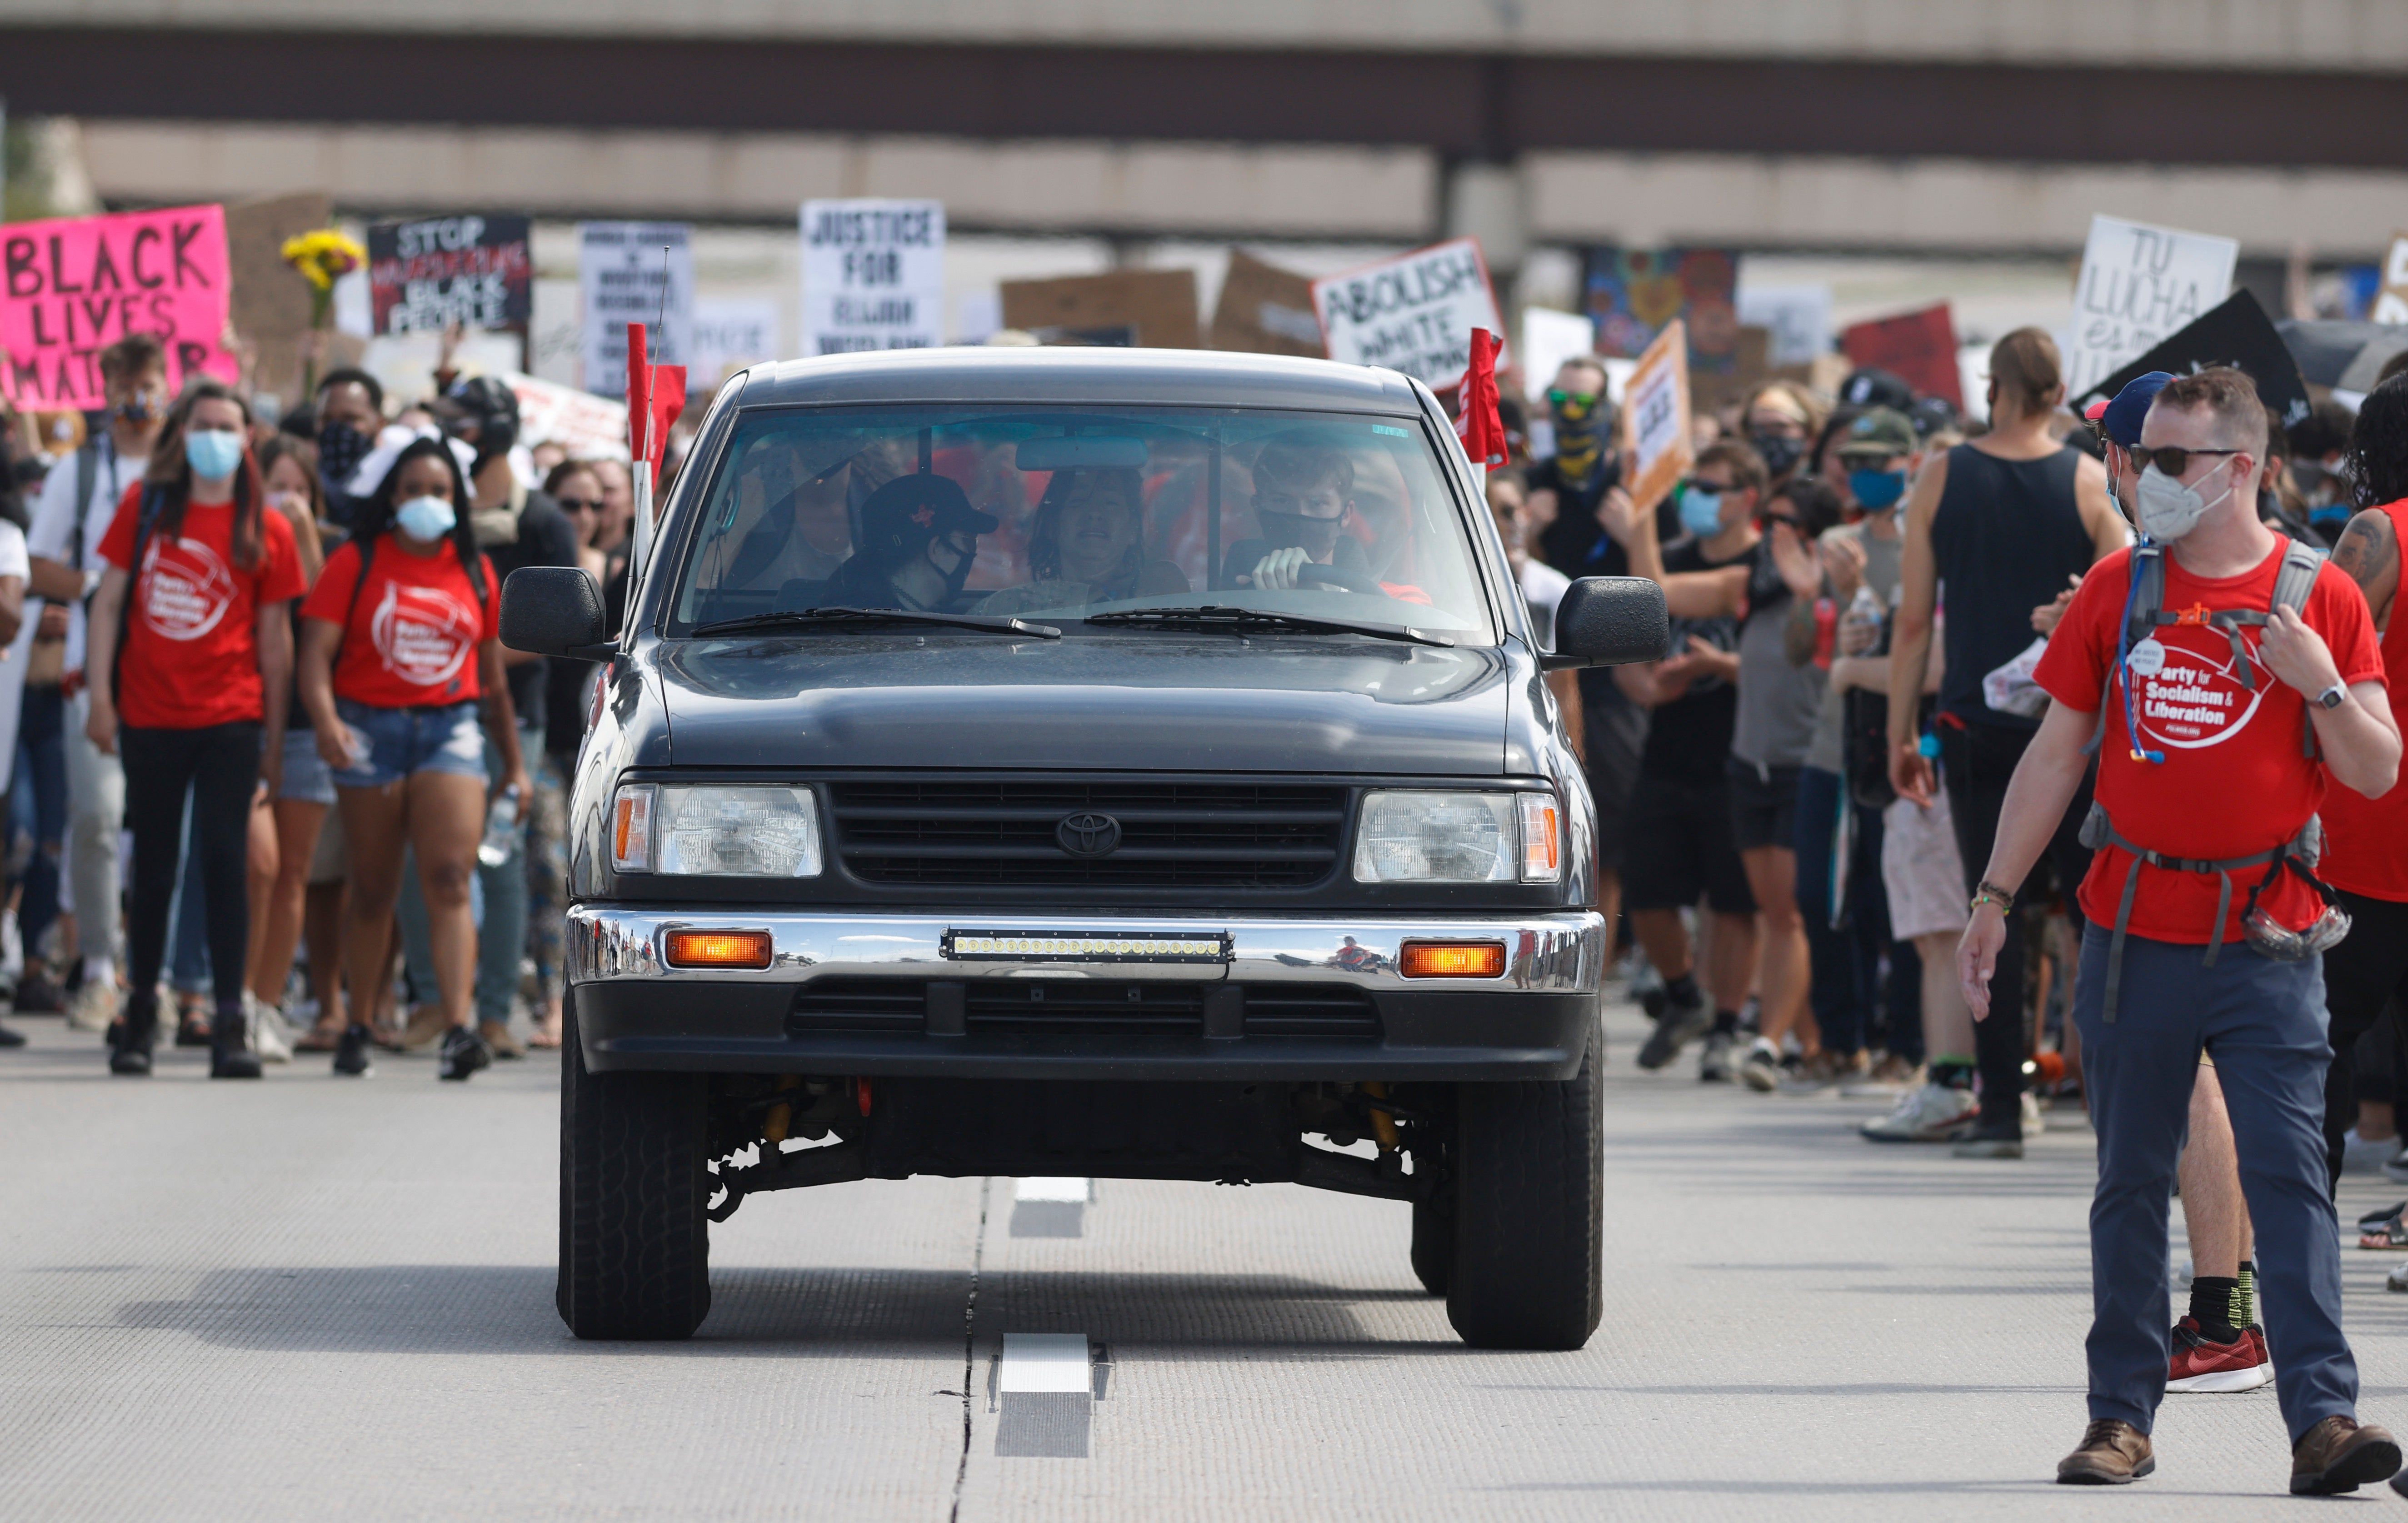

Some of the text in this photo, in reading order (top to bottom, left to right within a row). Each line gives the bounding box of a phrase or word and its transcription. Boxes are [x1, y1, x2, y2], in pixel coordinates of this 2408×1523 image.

[397, 215, 486, 258] STOP
[810, 209, 932, 247] JUSTICE
[2129, 228, 2176, 275] TU
[6, 221, 211, 296] BLACK
[843, 250, 902, 285] FOR
[1325, 250, 1483, 331] ABOLISH
[2085, 265, 2198, 328] LUCHA
[32, 296, 177, 344] LIVES
[1356, 304, 1457, 359] WHITE
[12, 341, 208, 400] MATR
[2146, 681, 2233, 707] Socialism &
[2198, 669, 2212, 685] for
[2145, 699, 2226, 726] Liberation
